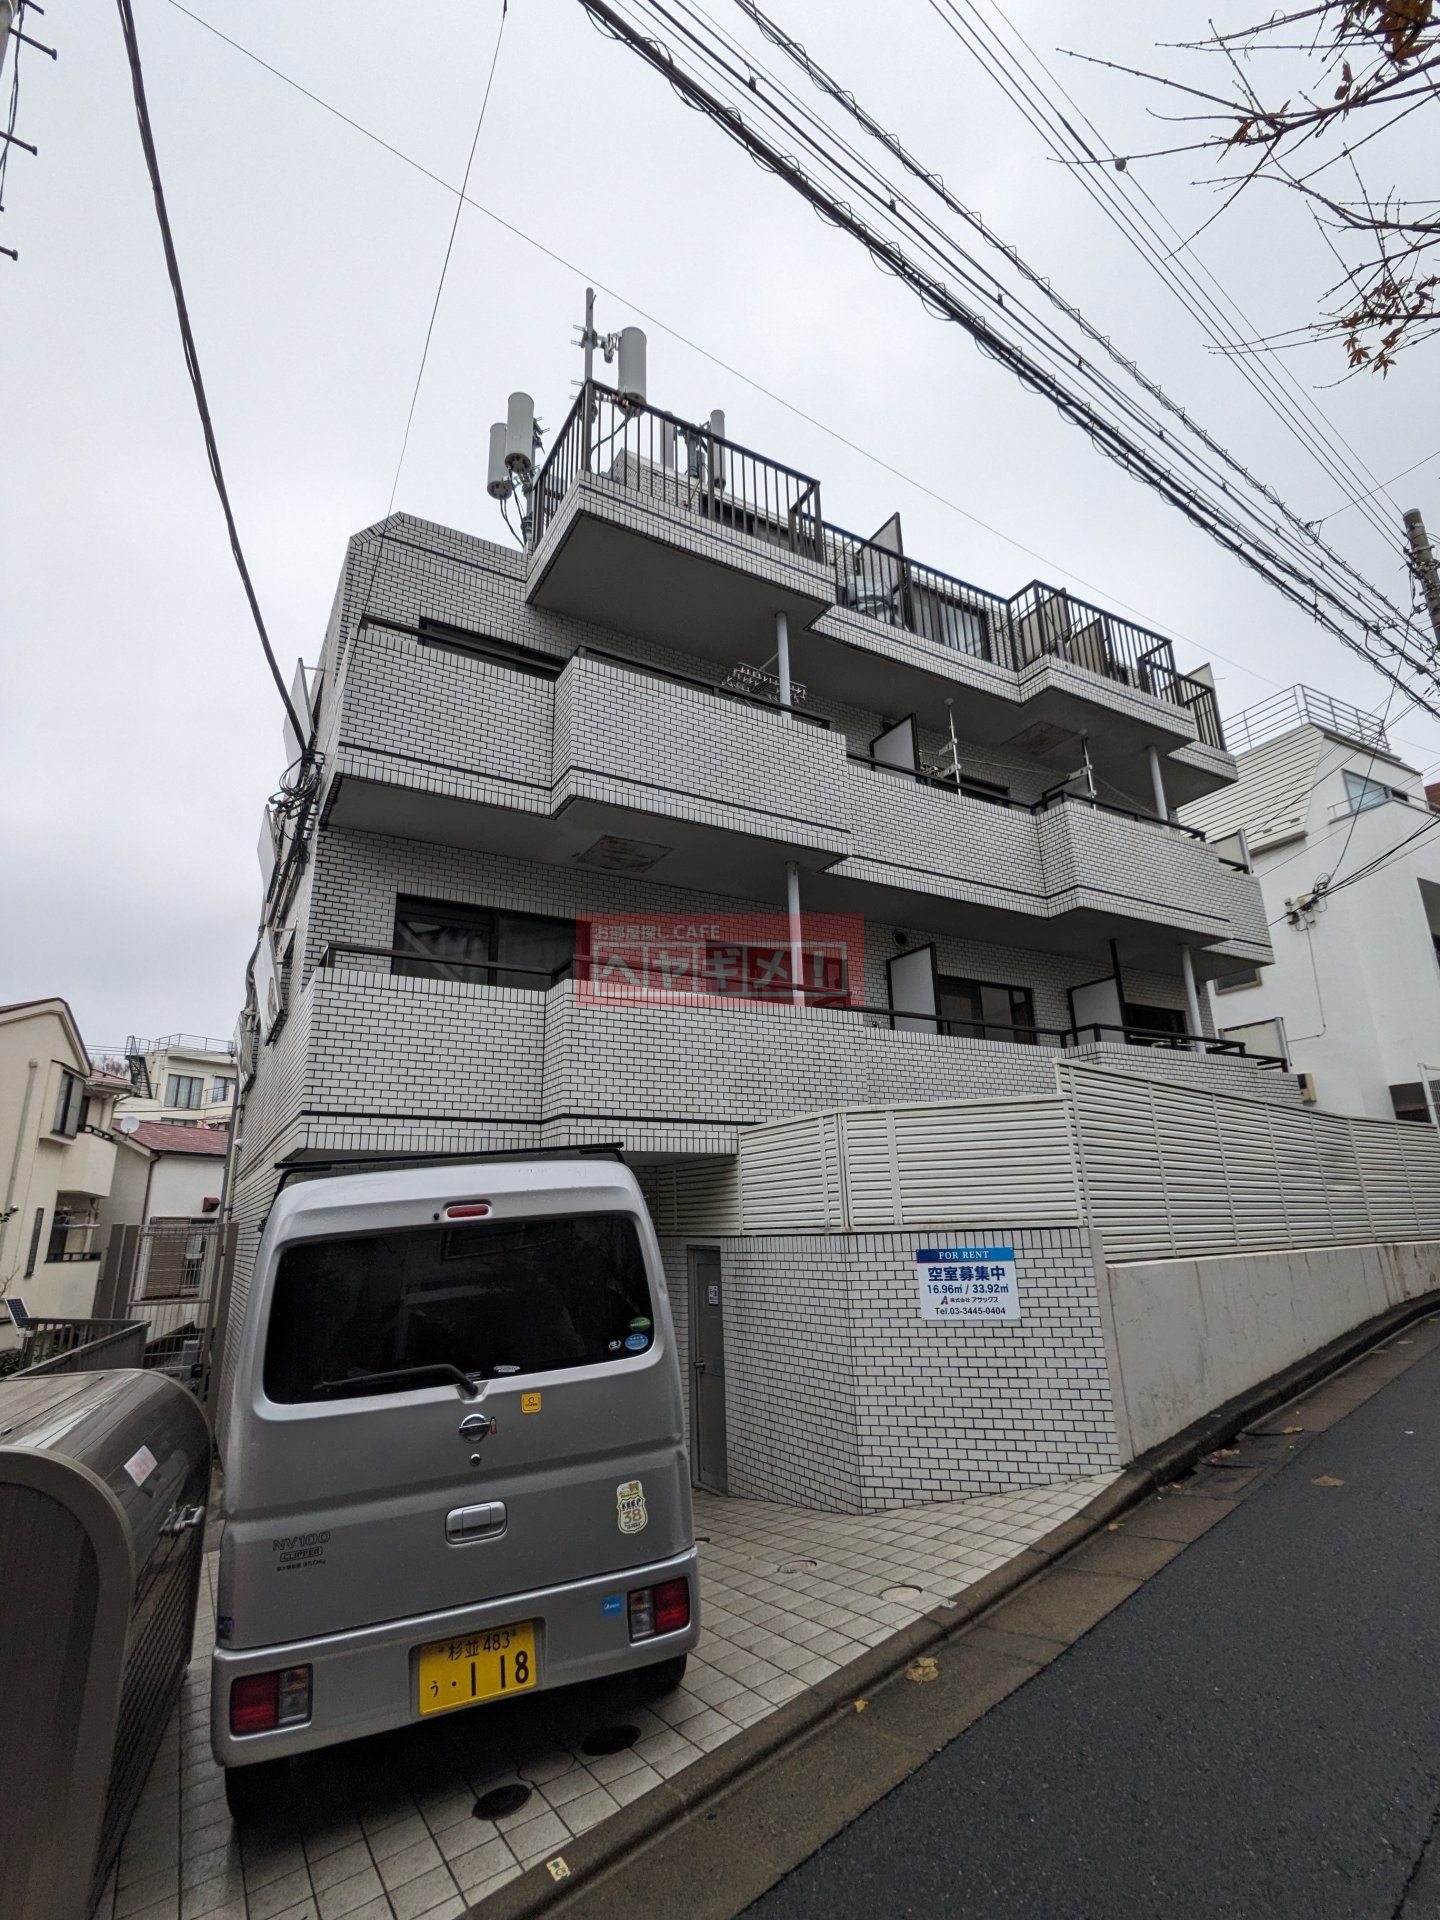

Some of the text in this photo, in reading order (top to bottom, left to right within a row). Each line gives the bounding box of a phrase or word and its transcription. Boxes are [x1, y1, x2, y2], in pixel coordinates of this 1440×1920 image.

[938, 1250, 989, 1260] FOR RENT
[927, 1265, 1006, 1282] 空室募集中
[623, 1508, 642, 1525] 38
[273, 1531, 331, 1552] NV100
[283, 1546, 320, 1561] CLIPPER
[448, 1631, 511, 1661] 杉並 483
